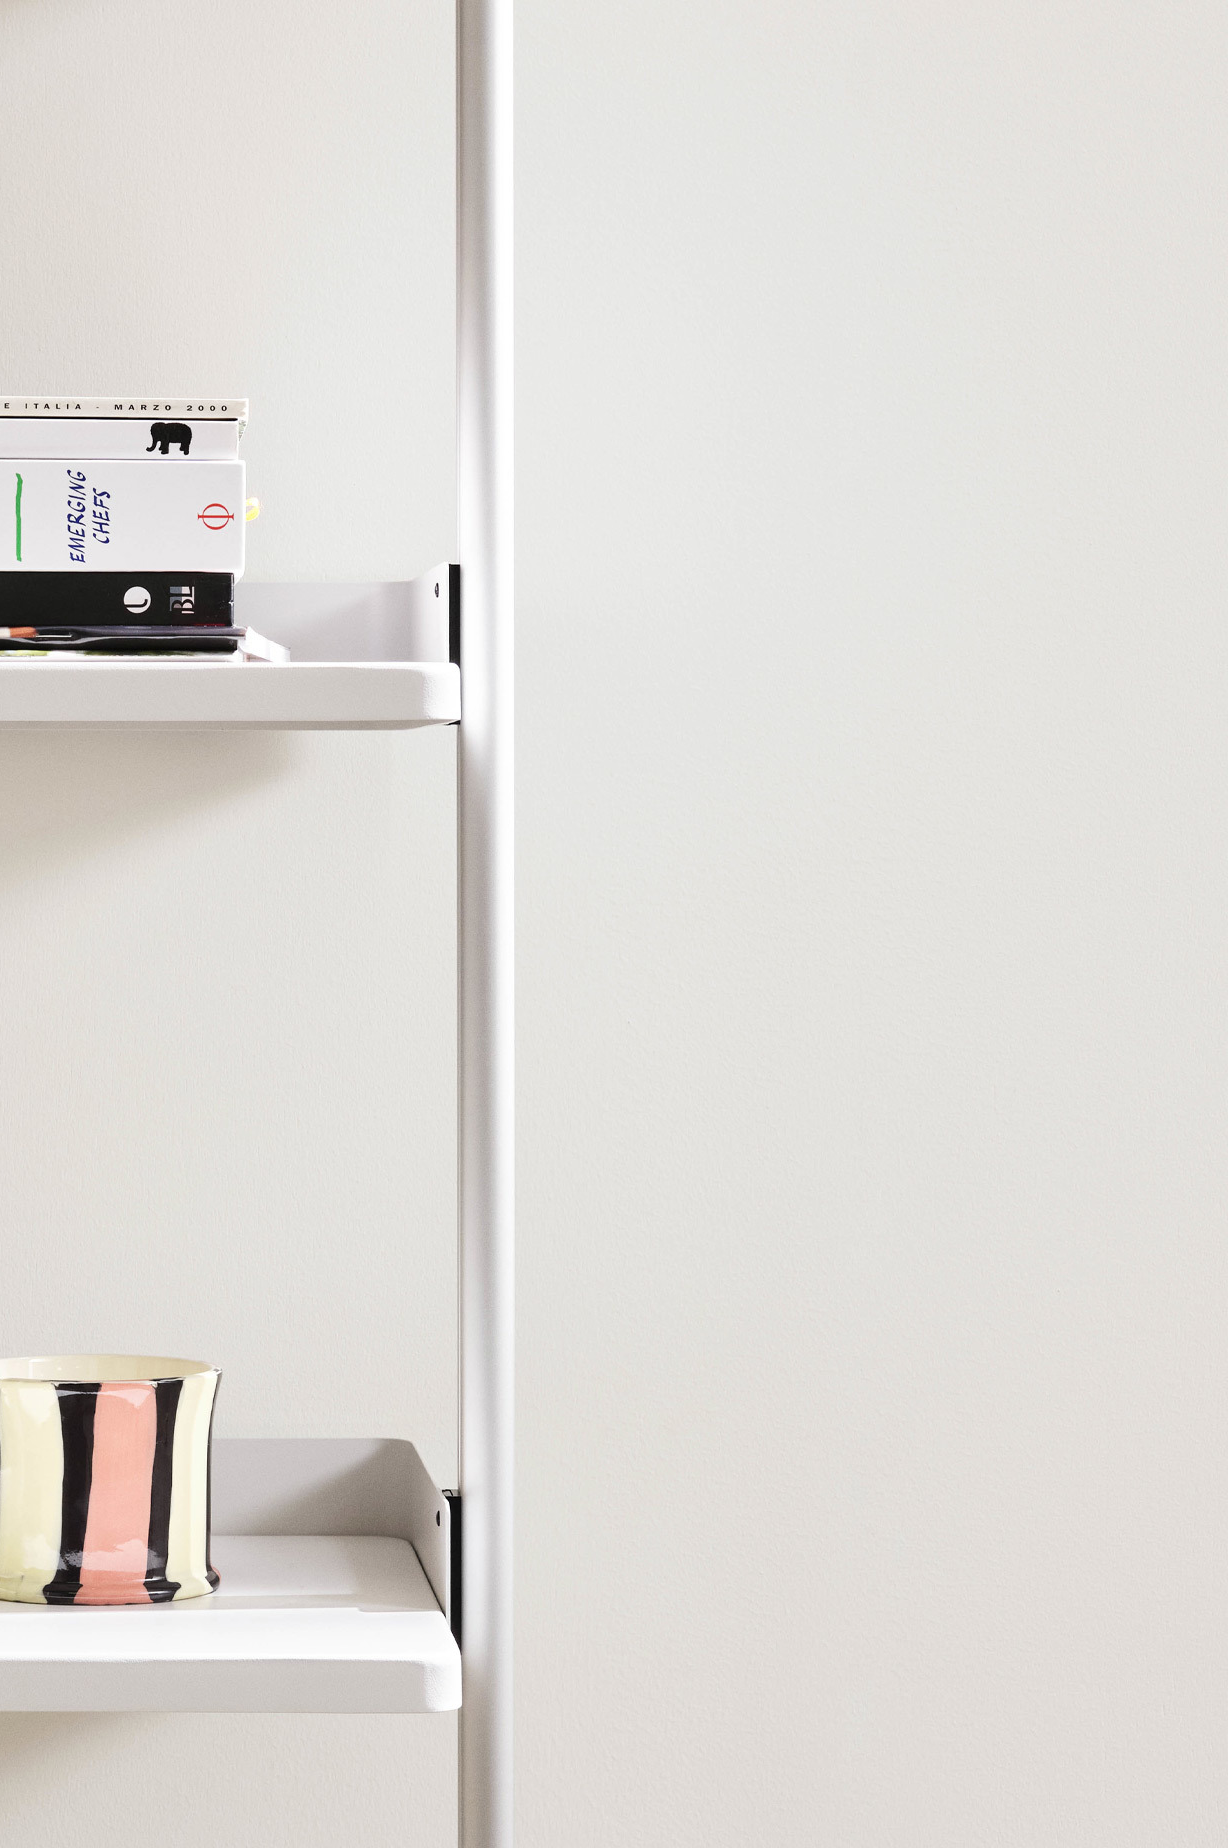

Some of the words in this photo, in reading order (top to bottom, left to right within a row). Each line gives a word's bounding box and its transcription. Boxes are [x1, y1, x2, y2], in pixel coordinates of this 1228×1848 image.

[25, 402, 82, 410] ITALIA
[186, 404, 228, 412] 2000
[66, 469, 87, 563] EMERGING
[91, 487, 111, 544] CHEFS
